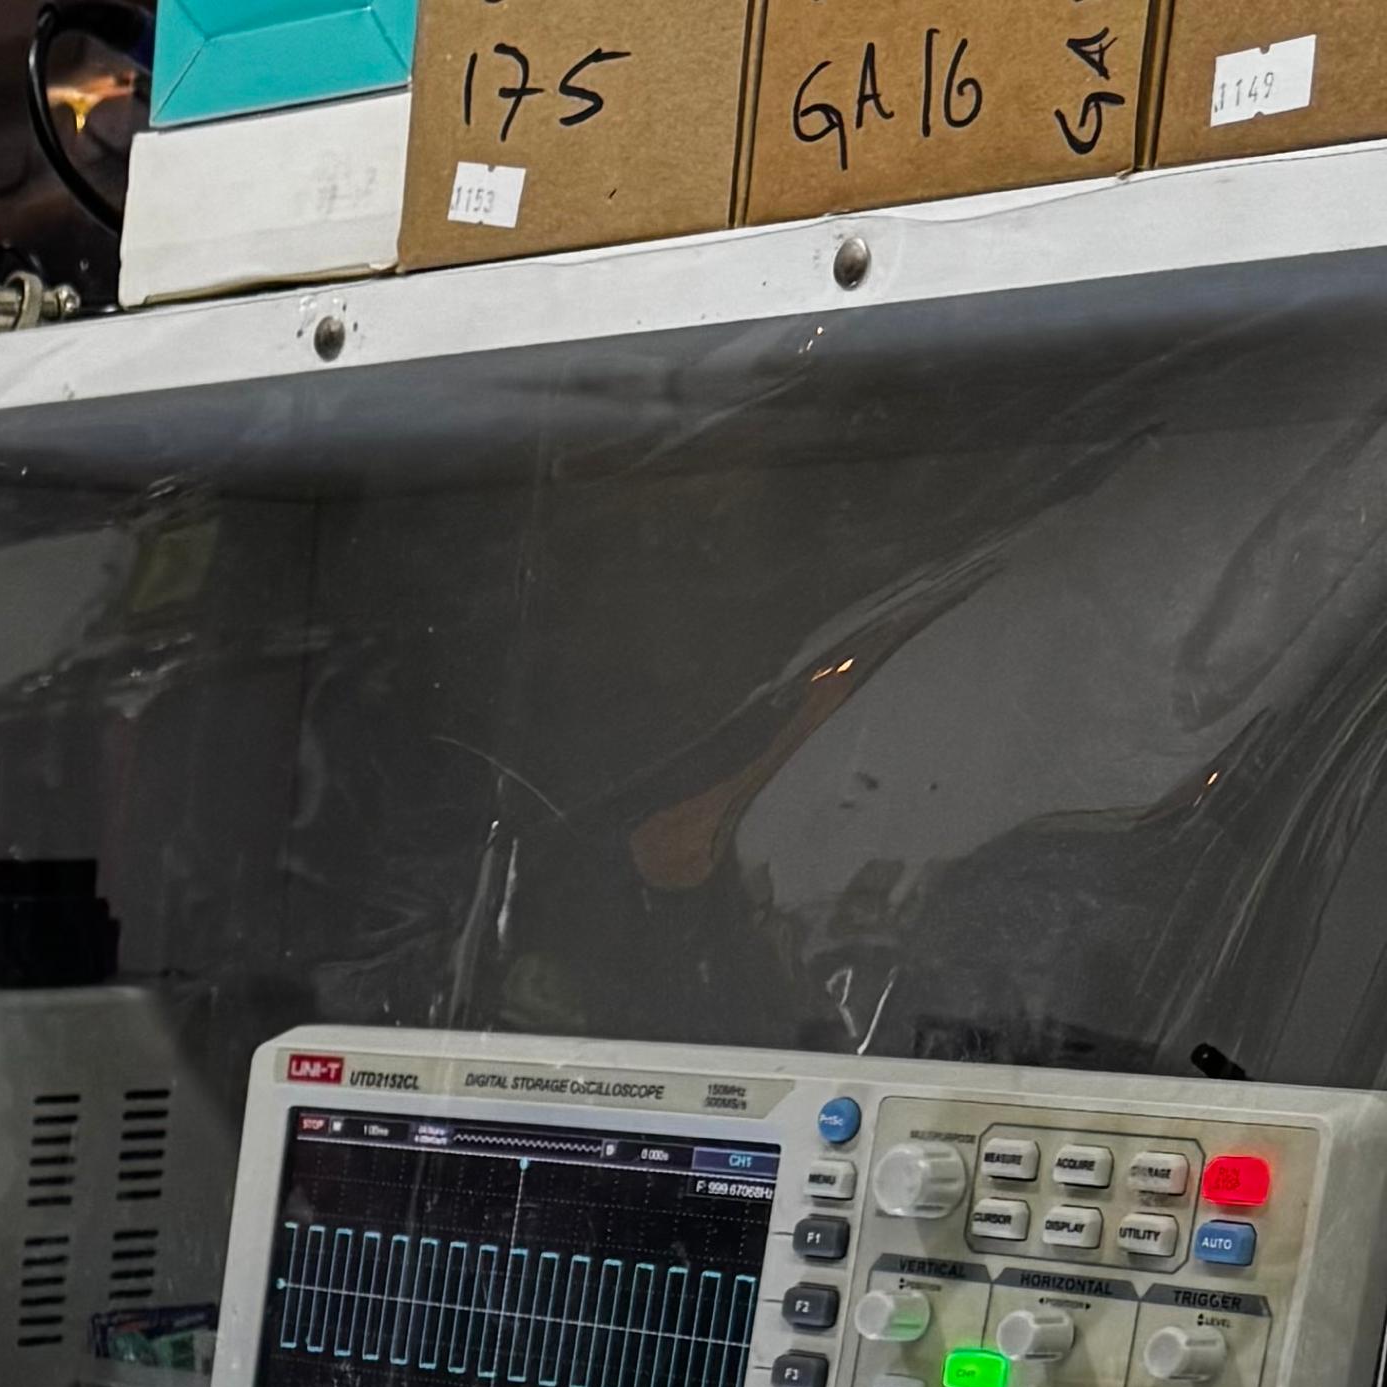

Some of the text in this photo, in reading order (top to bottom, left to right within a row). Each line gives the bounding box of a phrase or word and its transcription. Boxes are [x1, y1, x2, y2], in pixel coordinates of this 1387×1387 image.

[464, 43, 632, 142] 175
[290, 1060, 341, 1079] UNI-T
[350, 1070, 419, 1090] UTD2152CL
[465, 1072, 665, 1100] DIGITAL STORAGE OSCILLOSCOPE
[728, 1154, 753, 1169] CH1
[1055, 1157, 1096, 1172] ACQUIRE
[973, 1211, 1013, 1226] CURSOR
[1044, 1219, 1086, 1234] DISPLAY
[806, 1232, 821, 1244] F1
[1118, 1226, 1162, 1243] UTILITY
[1201, 1235, 1233, 1250] AUTO
[899, 1258, 967, 1279] VERTICAL
[1020, 1272, 1114, 1296] HORIZONTAL
[794, 1299, 810, 1313] F2
[1174, 1289, 1243, 1311] TRIGGER
[783, 1367, 799, 1381] F3
